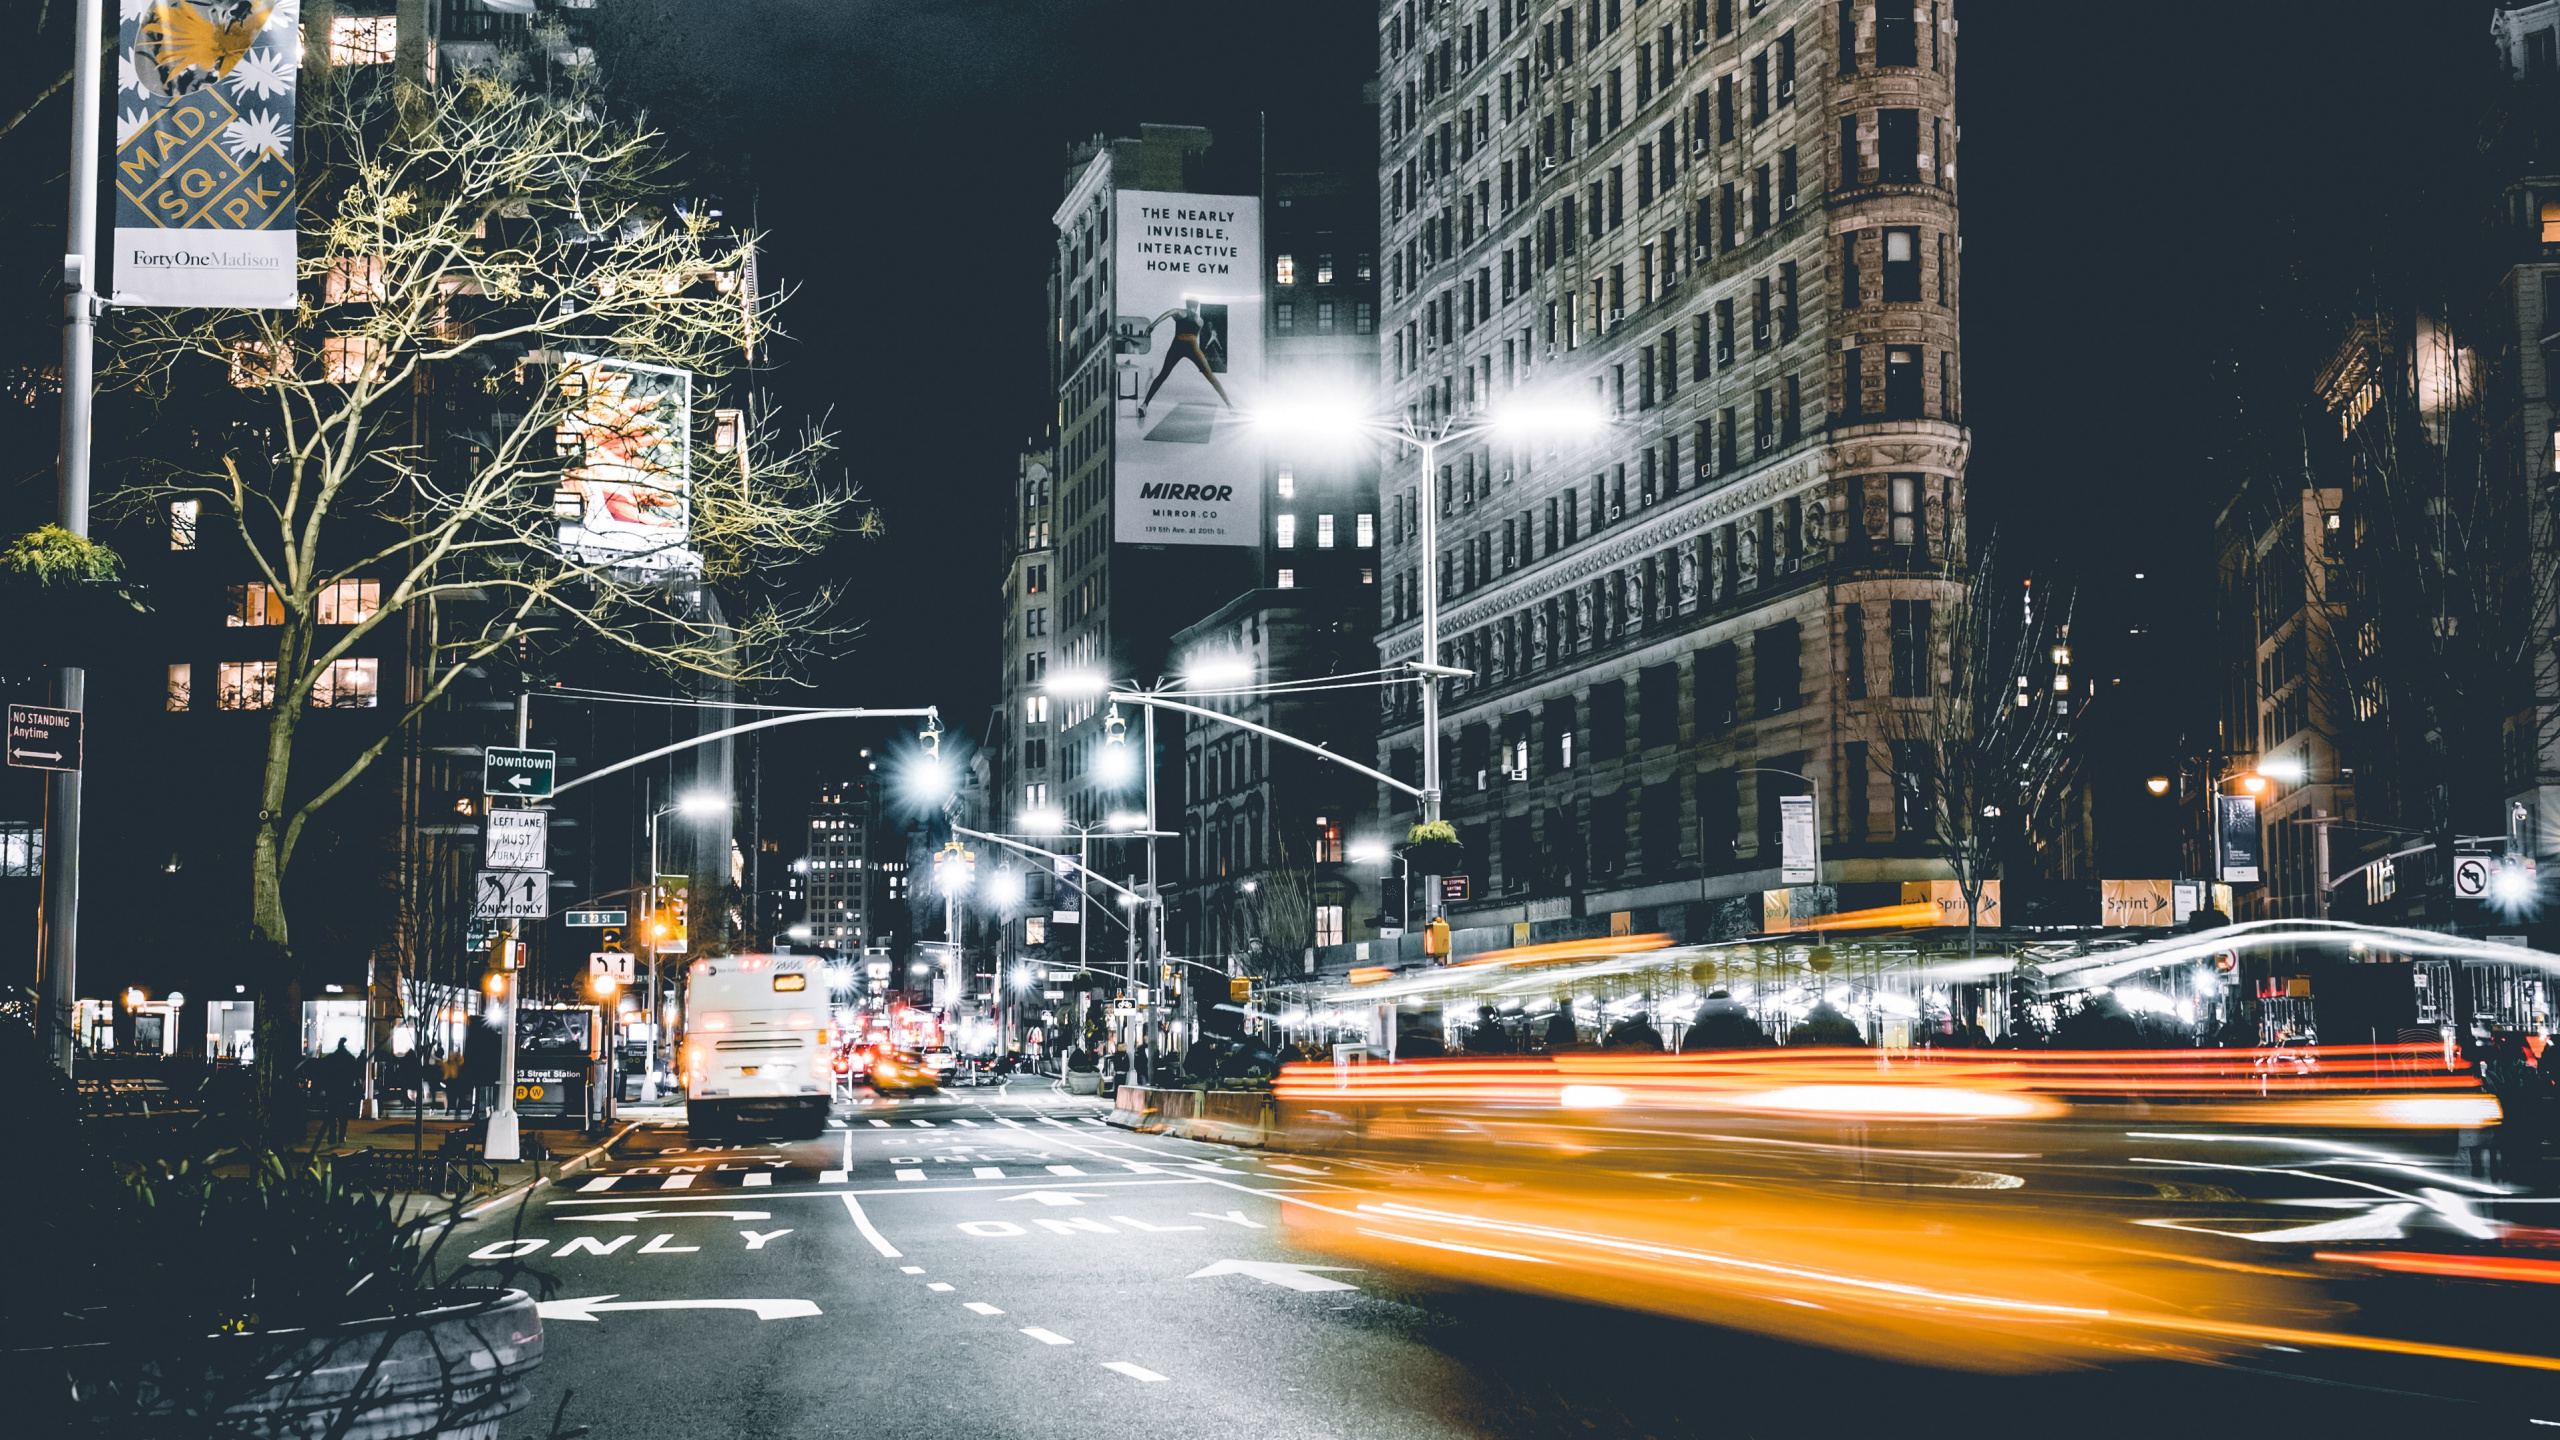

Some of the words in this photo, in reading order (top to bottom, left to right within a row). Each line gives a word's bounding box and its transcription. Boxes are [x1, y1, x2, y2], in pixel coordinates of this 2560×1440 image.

[119, 106, 218, 185] MAD.
[158, 168, 227, 219] SQ.
[222, 174, 288, 229] PK.
[1141, 207, 1170, 219] THE
[1177, 209, 1234, 222] NEARLY
[1147, 225, 1229, 241] INVISIBLE,
[1138, 242, 1238, 257] INTERACTIVE
[133, 250, 279, 269] FortyOneMadison
[1147, 260, 1190, 272] HOME
[1197, 263, 1229, 274] GYM
[1139, 482, 1233, 501] MIRROR
[1152, 509, 1218, 519] MIRROR.CO
[13, 711, 26, 723] NO
[28, 713, 70, 728] STANDING
[13, 725, 49, 740] Anytime
[488, 754, 552, 769] Downtown
[493, 817, 515, 827] LEFT
[518, 818, 541, 828] LANE
[501, 834, 531, 846] MUST
[493, 851, 515, 861] TURN
[519, 852, 540, 862] LEFT
[480, 904, 508, 914] ONLY
[515, 904, 543, 914] ONLY
[2107, 897, 2148, 912] Sprint
[581, 915, 587, 923] E
[589, 915, 599, 923] 23
[602, 914, 611, 923] St
[527, 1069, 551, 1077] Street
[553, 1069, 581, 1077] Station
[659, 1141, 793, 1155] ONLY
[889, 1150, 1051, 1164] ONLY
[956, 1210, 1268, 1237] ONLY
[468, 1228, 795, 1260] ONLY
